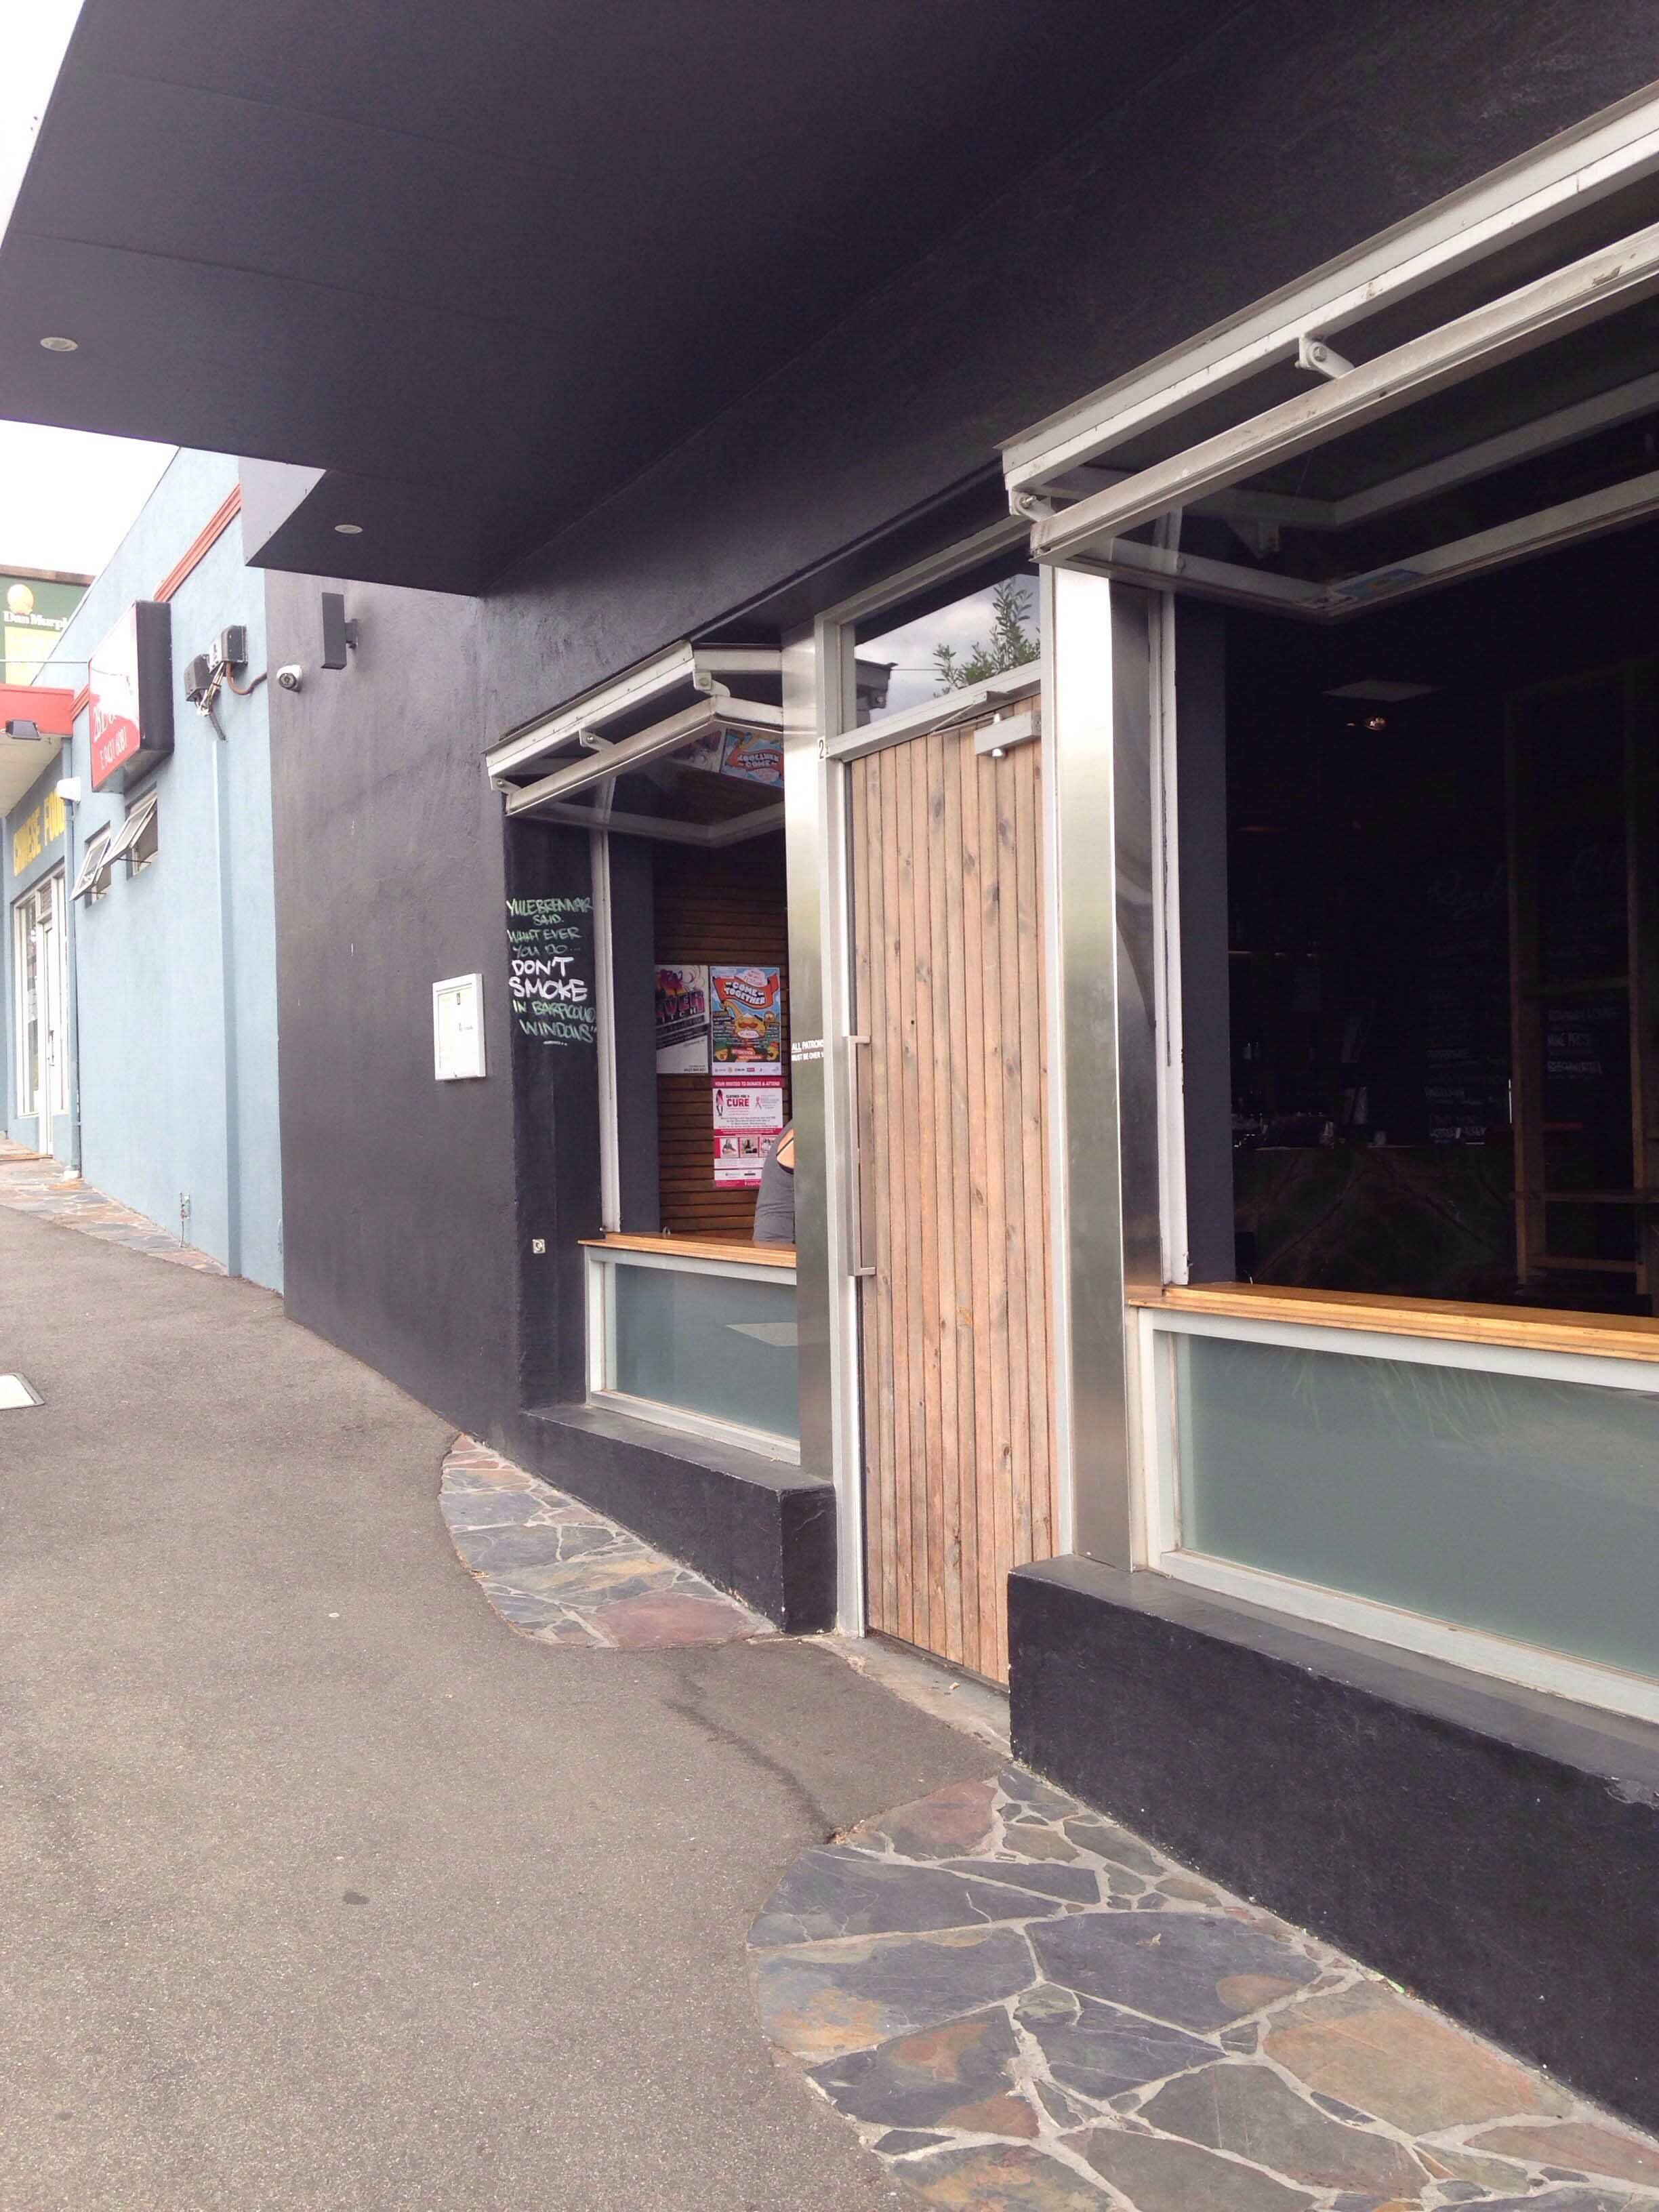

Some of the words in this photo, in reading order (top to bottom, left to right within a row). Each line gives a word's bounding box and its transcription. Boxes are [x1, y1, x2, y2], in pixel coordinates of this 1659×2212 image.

[3, 610, 30, 624] Dan
[30, 613, 68, 631] Murph
[513, 945, 540, 959] YOU
[512, 956, 574, 977] DON'T
[508, 976, 588, 1002] SMOKE
[724, 987, 766, 1004] TOGETHER
[732, 982, 758, 997] COME
[512, 1000, 527, 1013] IN
[792, 1042, 802, 1051] ALL
[726, 1099, 749, 1107] CURE
